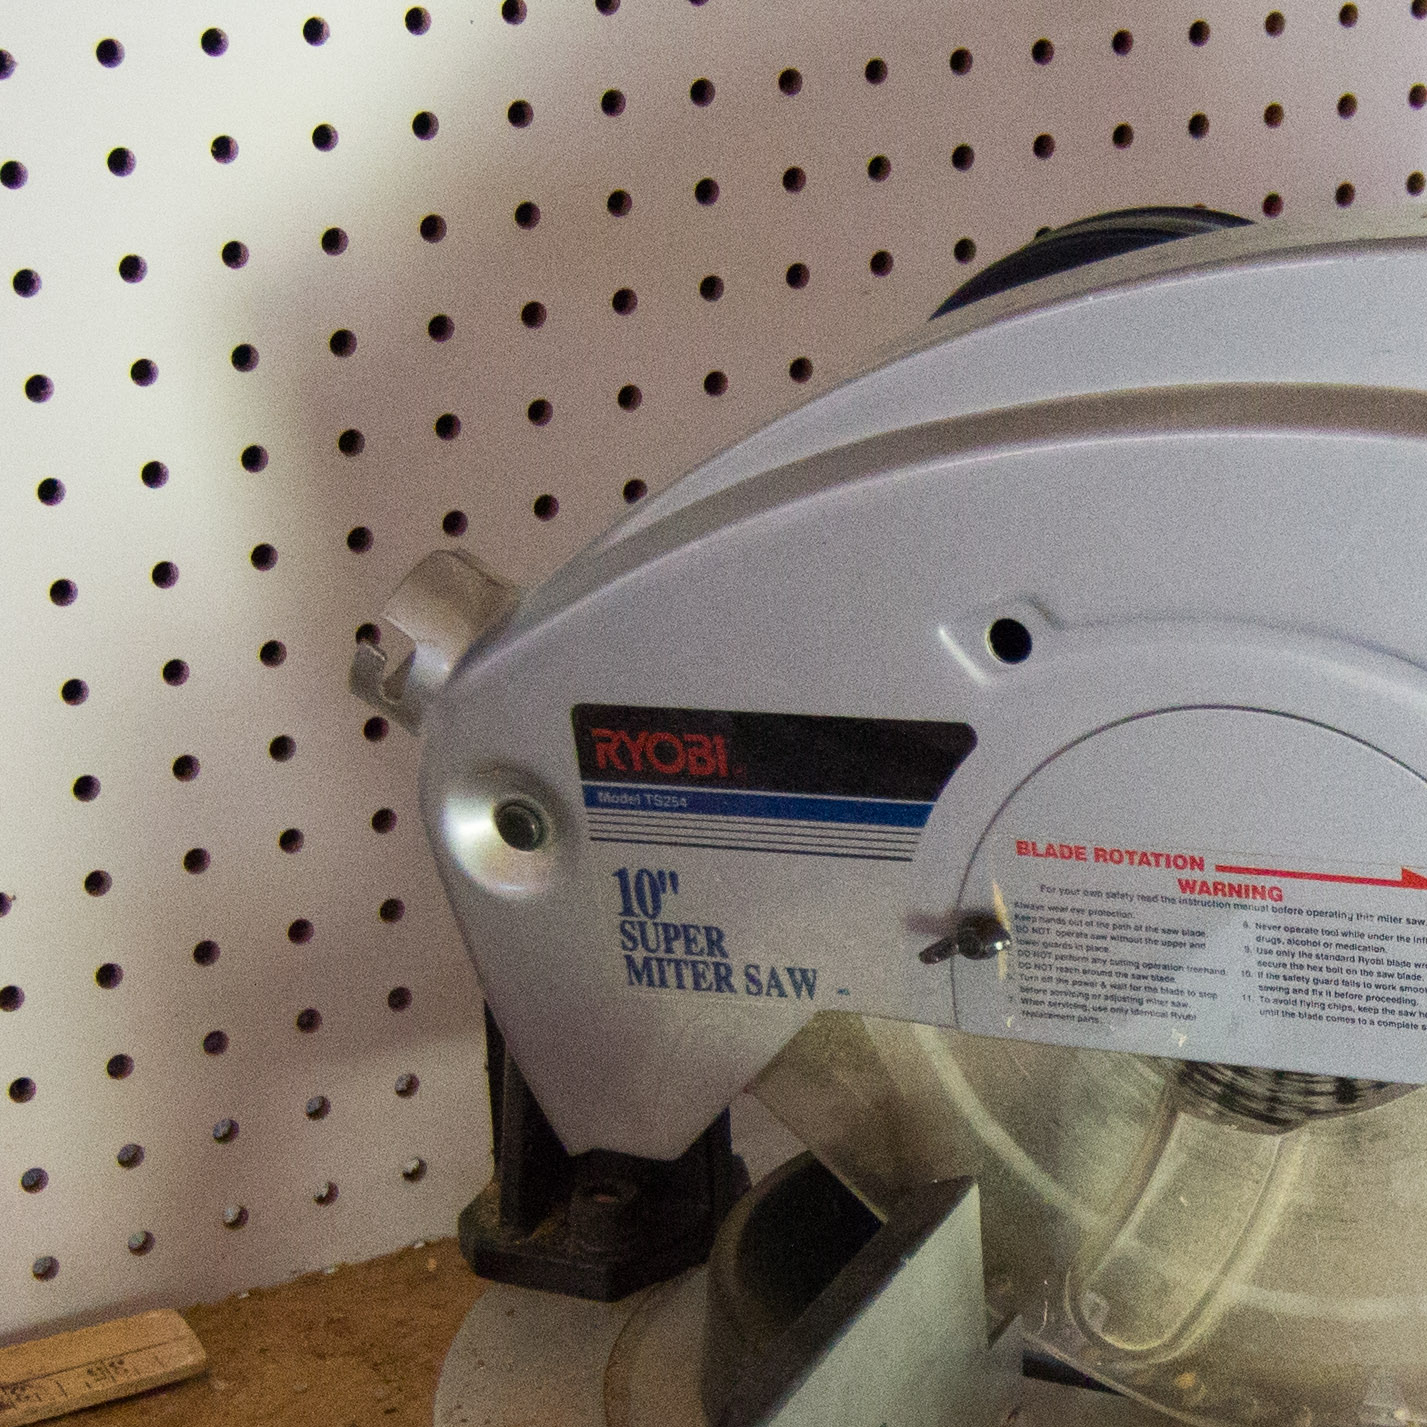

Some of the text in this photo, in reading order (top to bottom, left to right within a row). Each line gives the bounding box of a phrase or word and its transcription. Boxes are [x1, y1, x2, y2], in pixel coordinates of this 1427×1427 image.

[591, 728, 729, 776] RYOBI
[598, 791, 688, 808] Model TS254
[1015, 840, 1205, 872] BLADE ROTATION
[612, 866, 679, 919] 10"
[1177, 877, 1283, 902] WARNING
[1040, 884, 1055, 893] For
[1059, 887, 1079, 897] your
[1083, 889, 1102, 897] own
[1105, 890, 1133, 901] safety
[1137, 893, 1158, 902] read
[1160, 895, 1175, 903] the
[1178, 896, 1230, 908] instruction
[1233, 901, 1268, 912] manual
[1271, 905, 1303, 915] before
[1306, 908, 1353, 921] operating
[1377, 914, 1402, 924] miter
[1406, 918, 1427, 926] saw.
[619, 920, 729, 958] SUPER
[1255, 922, 1281, 931] Never
[1283, 924, 1318, 935] operate
[1321, 927, 1338, 936] tool
[1340, 929, 1364, 938] while
[1367, 931, 1392, 940] under
[1396, 934, 1409, 942] the
[1255, 934, 1284, 945] drugs,
[1287, 937, 1320, 947] alcohol
[1335, 941, 1386, 952] medication.
[1256, 947, 1273, 955] Use
[1275, 948, 1294, 958] only
[1298, 950, 1312, 958] the
[1315, 952, 1354, 962] standard
[1358, 955, 1384, 966] Ryobi
[1386, 958, 1410, 966] blade
[623, 954, 817, 1000] MITER SAW
[1257, 960, 1286, 968] secure
[1306, 963, 1322, 971] hex
[1325, 965, 1342, 973] bolt
[1397, 971, 1423, 980] blade.
[1266, 972, 1279, 980] the
[1282, 974, 1309, 984] safety
[1312, 976, 1338, 987] guard
[1342, 979, 1360, 987] fails
[1363, 980, 1371, 988] to
[1374, 981, 1396, 990] work
[1258, 984, 1289, 995] sawing
[1292, 987, 1308, 995] and
[1334, 990, 1362, 999] before
[1365, 993, 1418, 1006] proceeding.
[1272, 997, 1296, 1006] avoid
[1299, 999, 1325, 1010] flying
[1328, 1002, 1354, 1012] chips,
[1358, 1004, 1378, 1014] keep
[1382, 1006, 1395, 1014] the
[1259, 1008, 1278, 1017] until
[1282, 1010, 1295, 1018] the
[1298, 1012, 1322, 1020] blade
[1325, 1015, 1354, 1023] comes
[1377, 1019, 1418, 1030] complete
